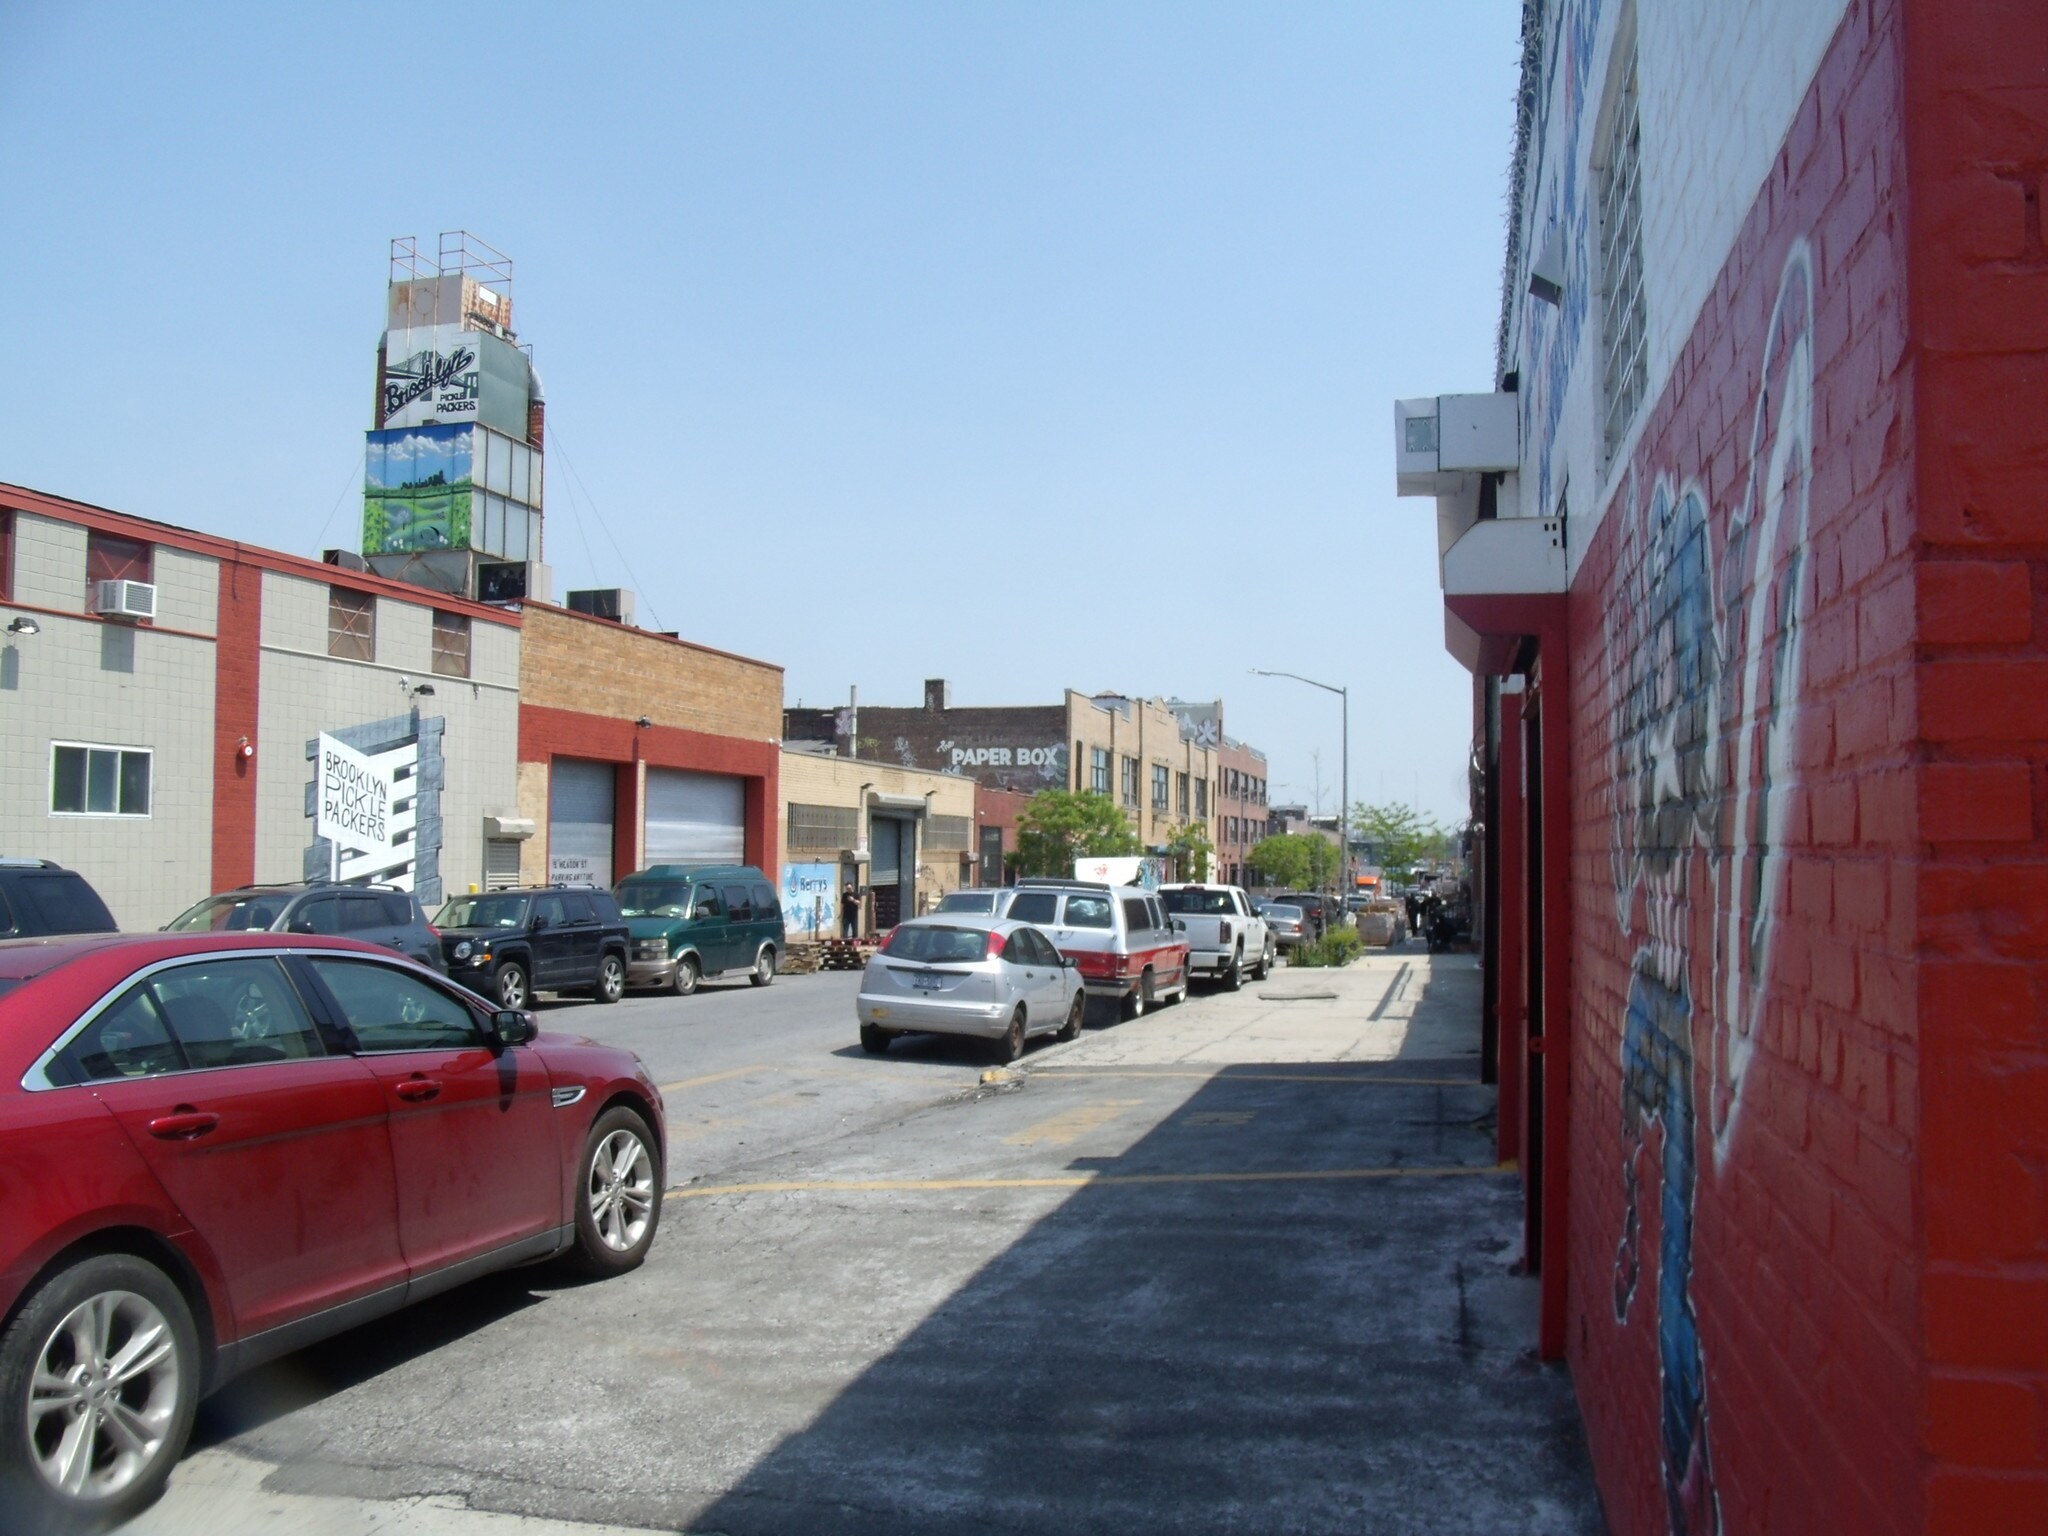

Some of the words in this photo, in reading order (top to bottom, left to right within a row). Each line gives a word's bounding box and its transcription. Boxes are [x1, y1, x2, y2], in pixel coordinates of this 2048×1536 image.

[385, 347, 475, 419] Brooklyn
[440, 393, 465, 402] PICKLE
[436, 401, 476, 413] PACKERS
[326, 751, 386, 800] BROOKLYN
[951, 747, 1013, 766] PAPER
[1016, 747, 1059, 766] BOX
[326, 773, 386, 821] PICKLE
[325, 800, 385, 842] PACKERS
